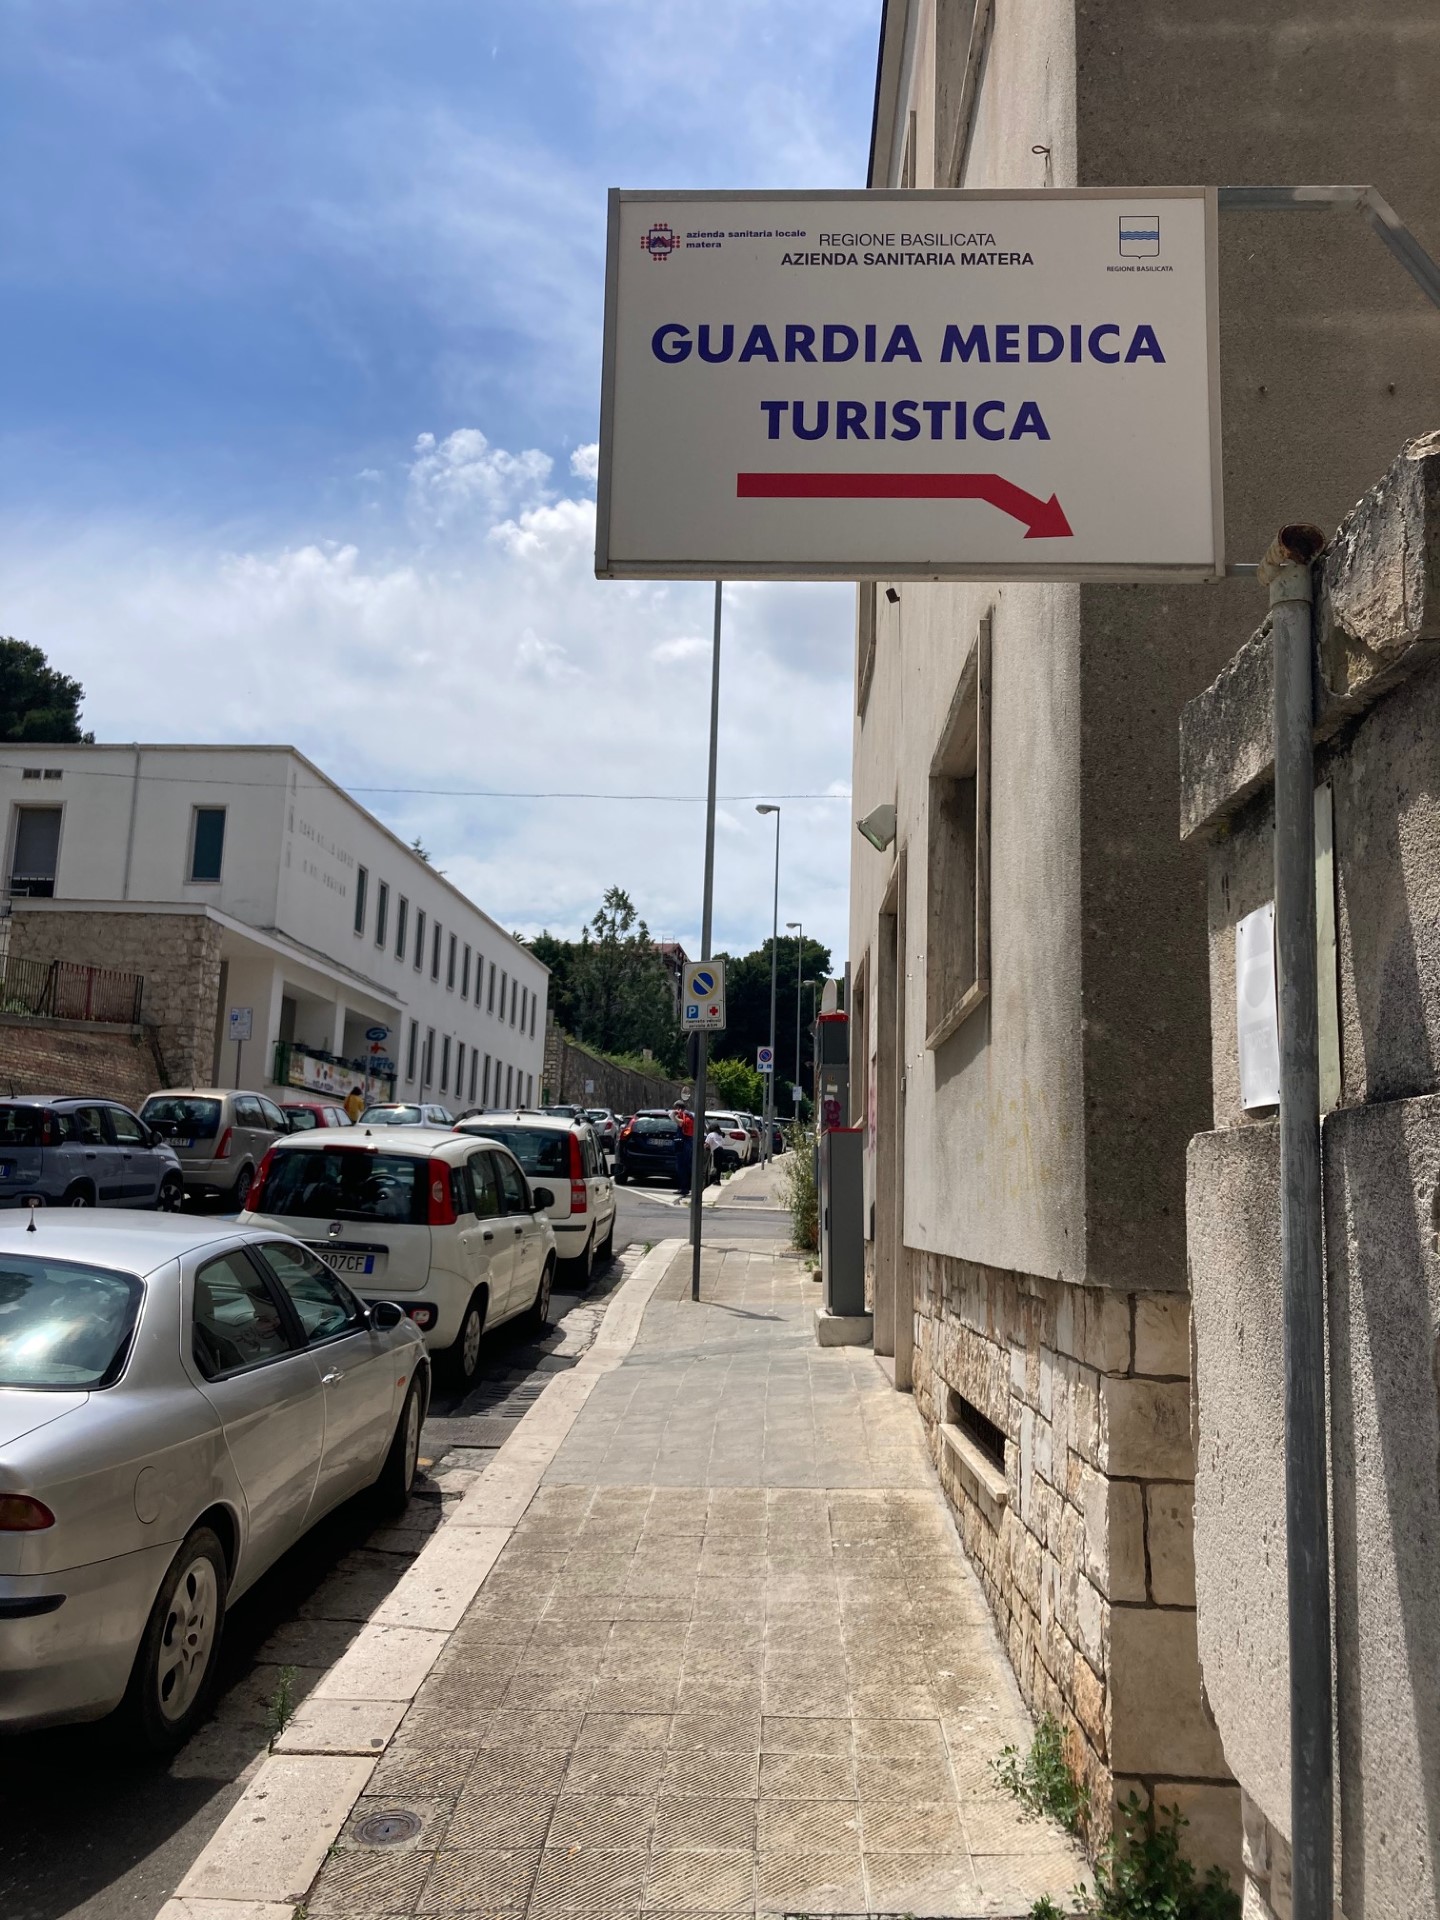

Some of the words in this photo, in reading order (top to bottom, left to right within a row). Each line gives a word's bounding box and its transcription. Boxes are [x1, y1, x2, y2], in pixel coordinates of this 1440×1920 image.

[686, 230, 725, 238] azienda
[728, 230, 773, 238] sanitaria
[775, 229, 807, 237] locale
[819, 233, 896, 247] REGIONE
[900, 233, 996, 246] BASILICATA
[781, 252, 859, 266] AZIENDA
[863, 252, 956, 266] SANITARIA
[961, 252, 1034, 266] MATERA
[651, 323, 923, 364] GUARDIA
[940, 323, 1167, 364] MEDICA
[760, 399, 1051, 441] TURISTICA
